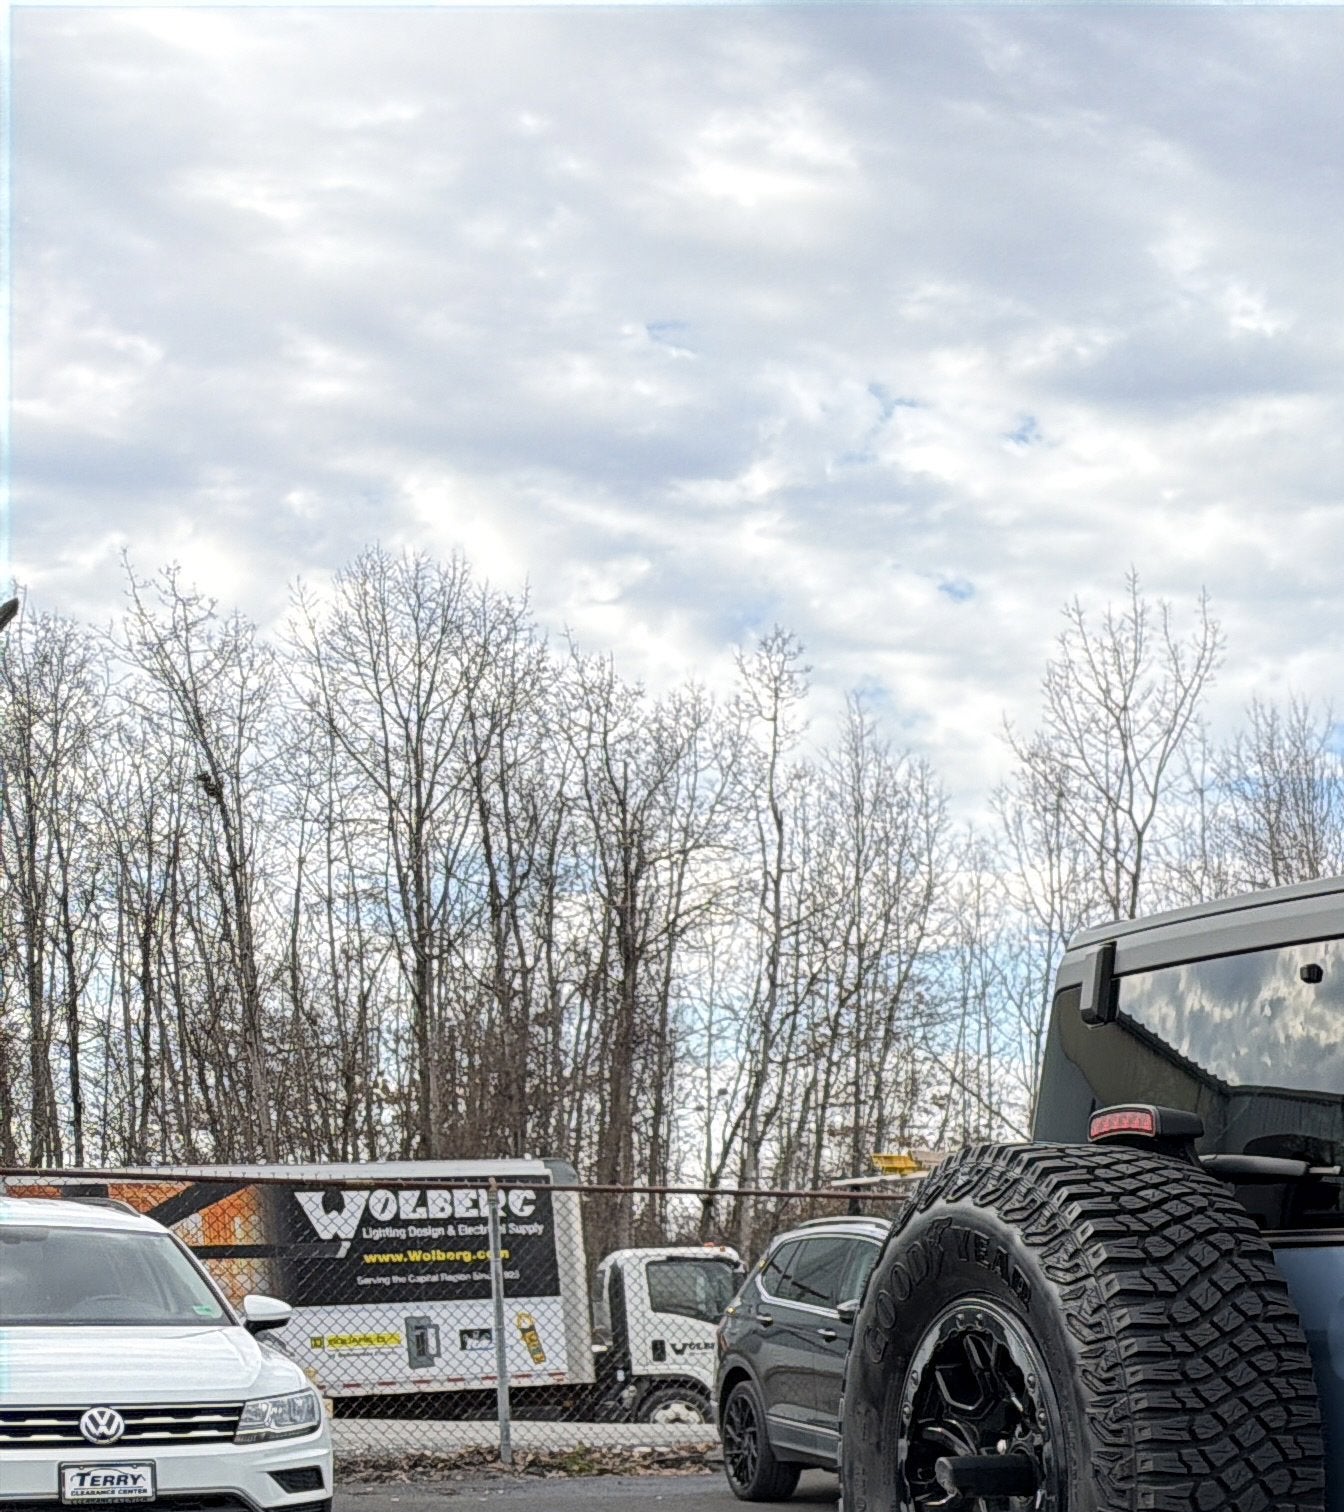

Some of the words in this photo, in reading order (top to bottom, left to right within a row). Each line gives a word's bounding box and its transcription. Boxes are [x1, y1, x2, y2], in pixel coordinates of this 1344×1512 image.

[294, 1188, 537, 1240] WOLBERG
[362, 1226, 406, 1240] Lighting
[408, 1225, 445, 1239] Design
[447, 1225, 457, 1237] &
[508, 1222, 545, 1236] Supply
[357, 1275, 391, 1286] Serving
[392, 1274, 407, 1284] the
[408, 1273, 439, 1284] Capital
[440, 1272, 471, 1283] Region
[864, 1217, 1031, 1363] GOODYEAR
[76, 1472, 142, 1487] TERRY
[117, 1488, 148, 1496] CENTER
